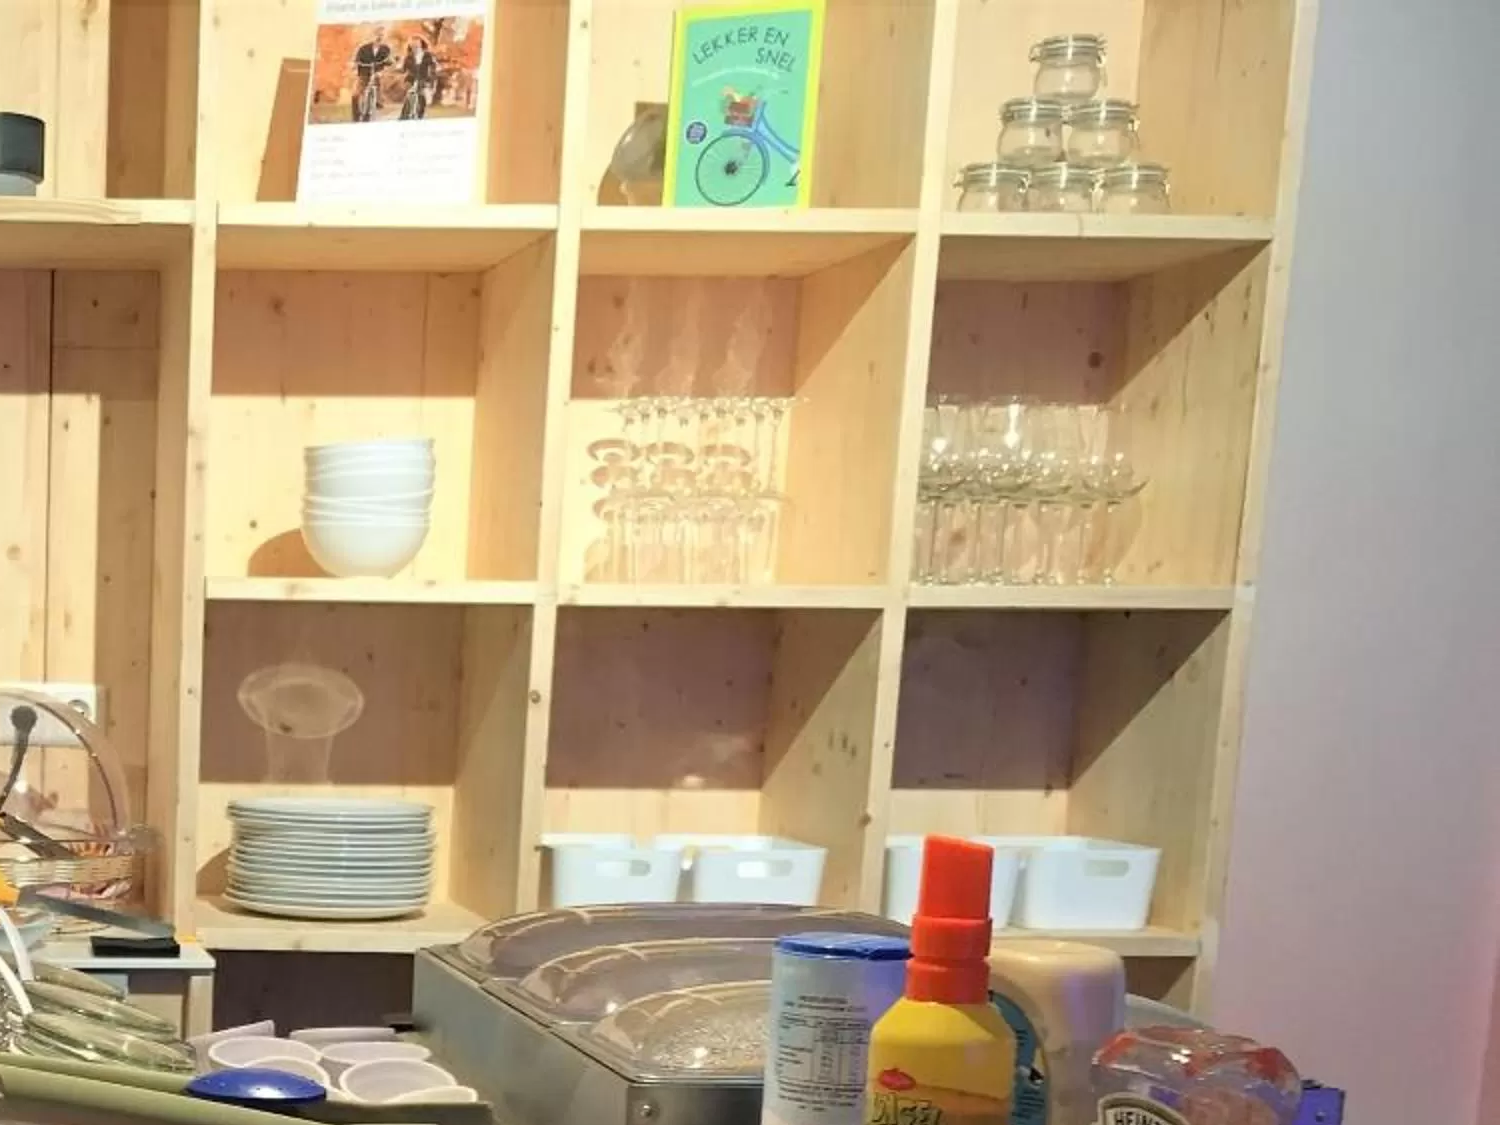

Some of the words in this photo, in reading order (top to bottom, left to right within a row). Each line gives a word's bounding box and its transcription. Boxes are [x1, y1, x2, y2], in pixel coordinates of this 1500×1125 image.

[691, 26, 759, 65] LEKKER
[763, 26, 790, 47] EN
[755, 47, 796, 72] SNEL
